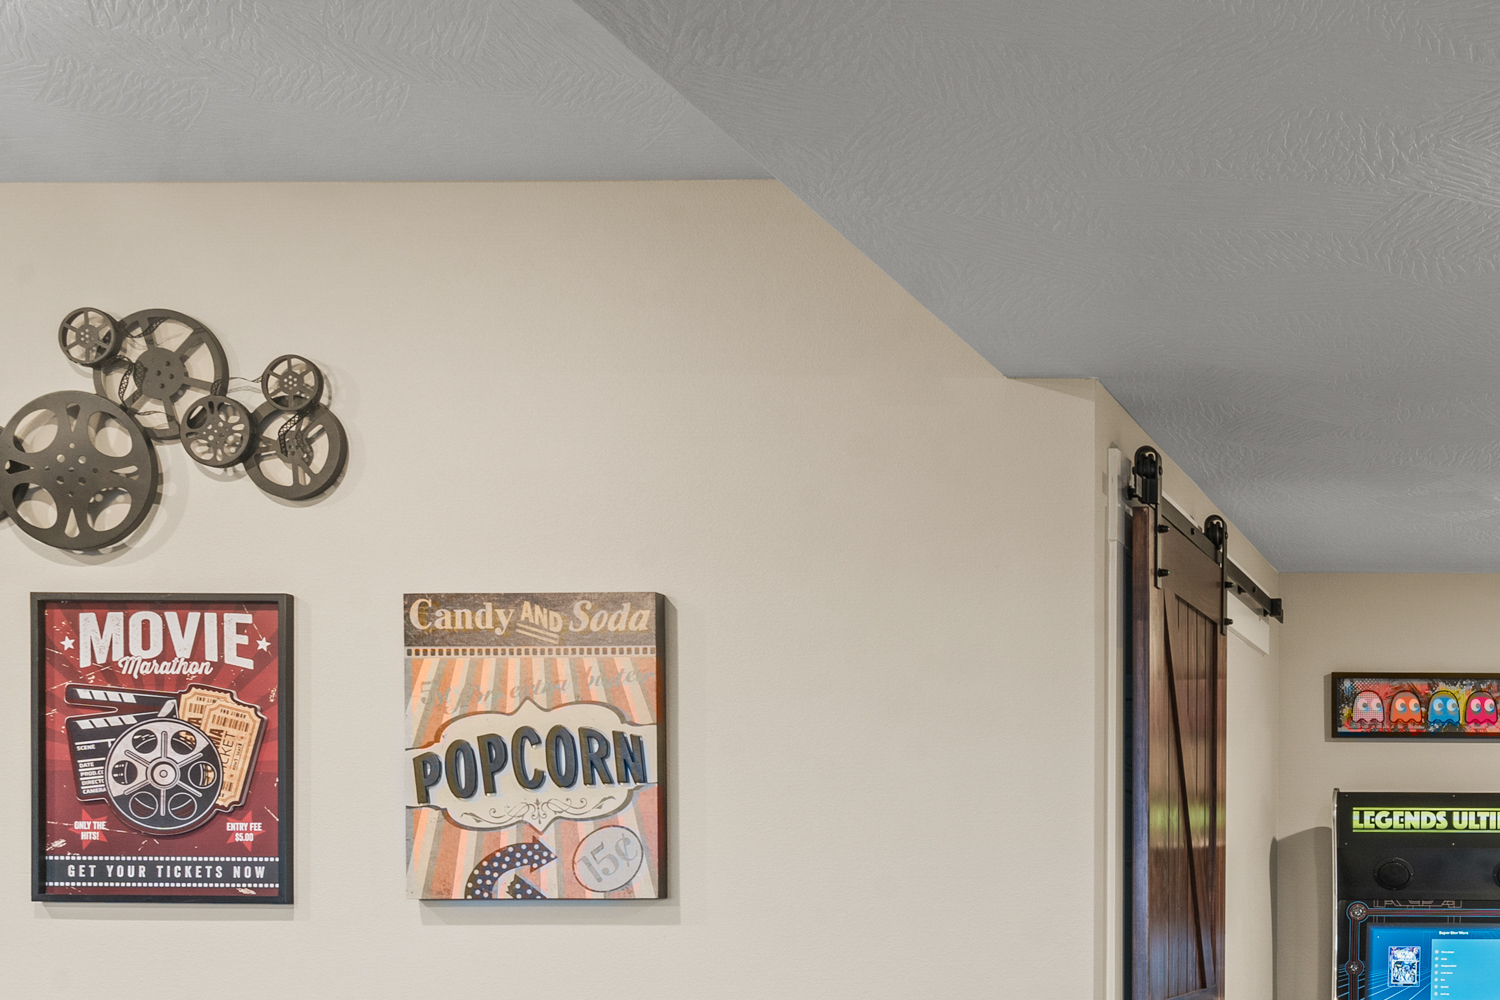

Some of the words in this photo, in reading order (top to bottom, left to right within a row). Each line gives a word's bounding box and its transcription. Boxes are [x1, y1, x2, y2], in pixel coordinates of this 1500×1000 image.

[409, 598, 514, 637] Candy
[520, 600, 563, 634] AND
[568, 599, 650, 634] Soda
[79, 610, 254, 670] MOVIE
[118, 655, 214, 680] Marathon
[412, 723, 648, 805] POPCORN
[74, 821, 91, 830] ONLY
[92, 821, 106, 830] THE
[226, 822, 248, 832] ENTRY
[249, 822, 263, 832] FEE
[1352, 810, 1448, 830] LEGENDS
[80, 831, 100, 841] HITS!
[234, 832, 254, 842] $5.00
[576, 833, 640, 884] 15¢
[67, 864, 97, 878] GET
[106, 864, 147, 878] YOUR
[156, 865, 223, 879] TICKETS
[233, 865, 266, 879] NOW
